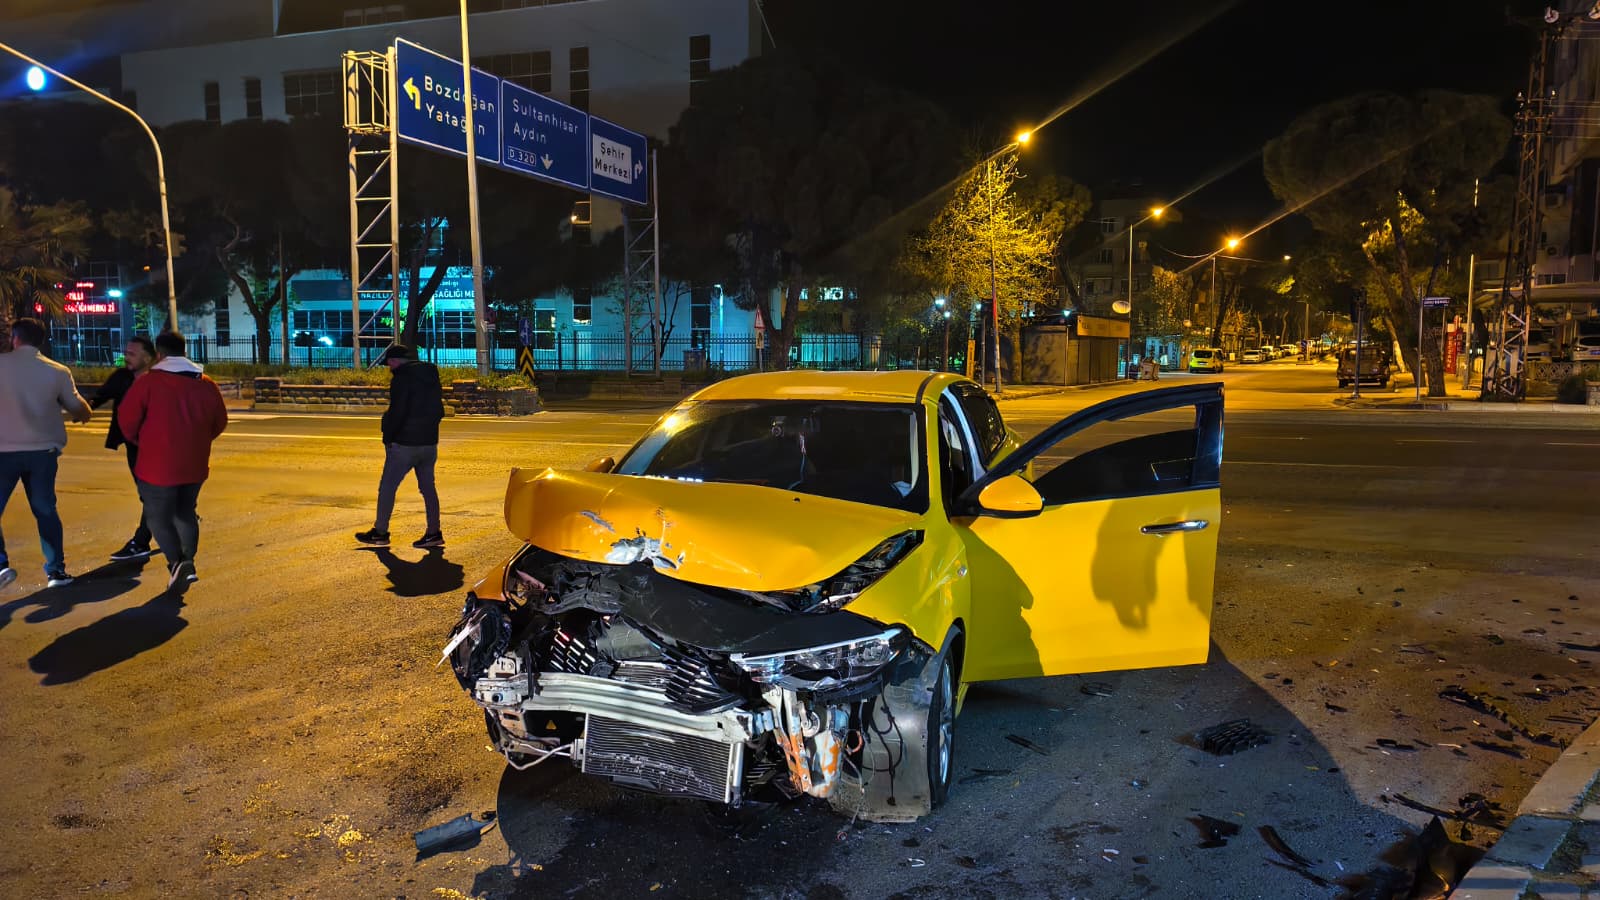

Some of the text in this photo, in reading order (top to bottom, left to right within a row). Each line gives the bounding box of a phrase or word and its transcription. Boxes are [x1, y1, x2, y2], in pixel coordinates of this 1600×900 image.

[425, 103, 485, 136] Yatağn
[512, 98, 579, 135] Sultanhisar
[513, 122, 547, 145] Aydın
[509, 148, 535, 165] D 320
[600, 142, 625, 161] Şehir
[594, 157, 632, 180] Merkezi
[435, 288, 463, 299] SAĞLIĞI
